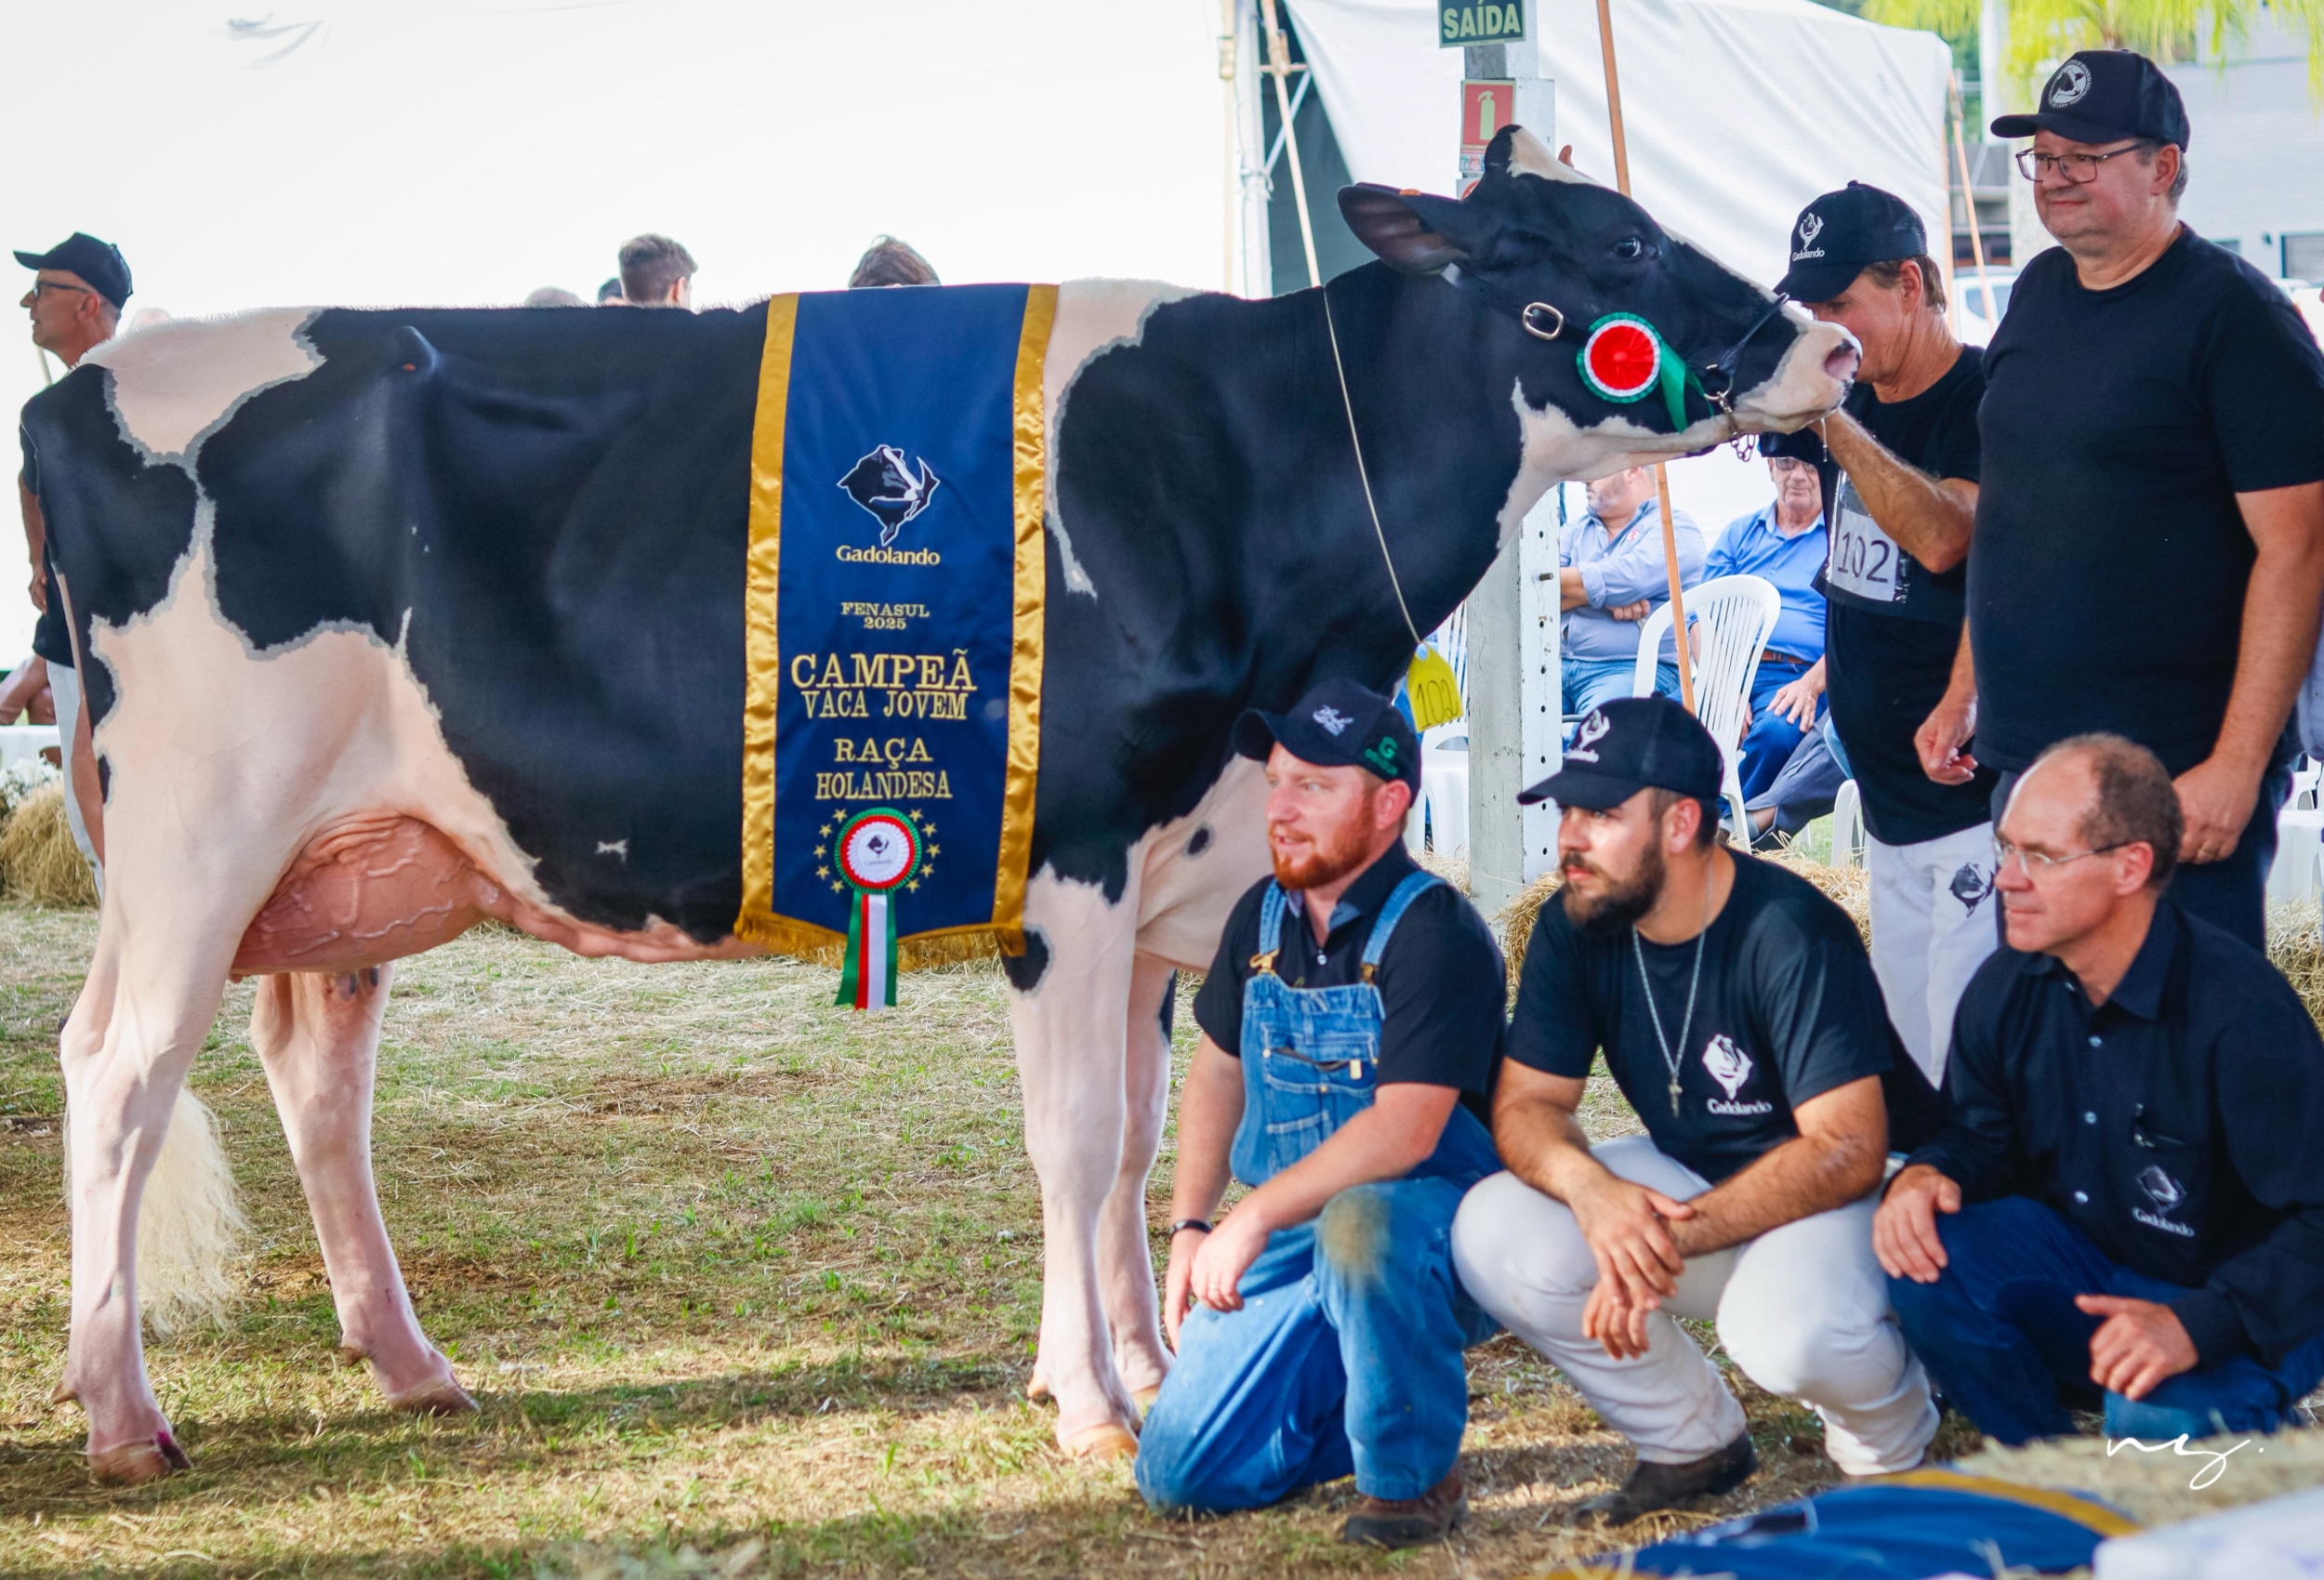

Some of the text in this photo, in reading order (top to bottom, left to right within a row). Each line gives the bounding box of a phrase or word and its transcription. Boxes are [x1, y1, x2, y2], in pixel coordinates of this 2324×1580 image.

[1443, 0, 1521, 39] SAÍDA
[836, 545, 941, 565] Gadolando
[1837, 532, 1891, 584] 102
[840, 602, 931, 617] FENASUL
[864, 616, 907, 630] 2025
[791, 648, 978, 691] CAMPEÃ
[800, 690, 969, 720] VACA JOVEM
[1416, 678, 1459, 729] 102
[834, 737, 934, 770] RAÇA
[814, 770, 954, 800] HOLANDESA
[1707, 1098, 1773, 1115] Gadolando
[2133, 1207, 2194, 1237] Gadolando
